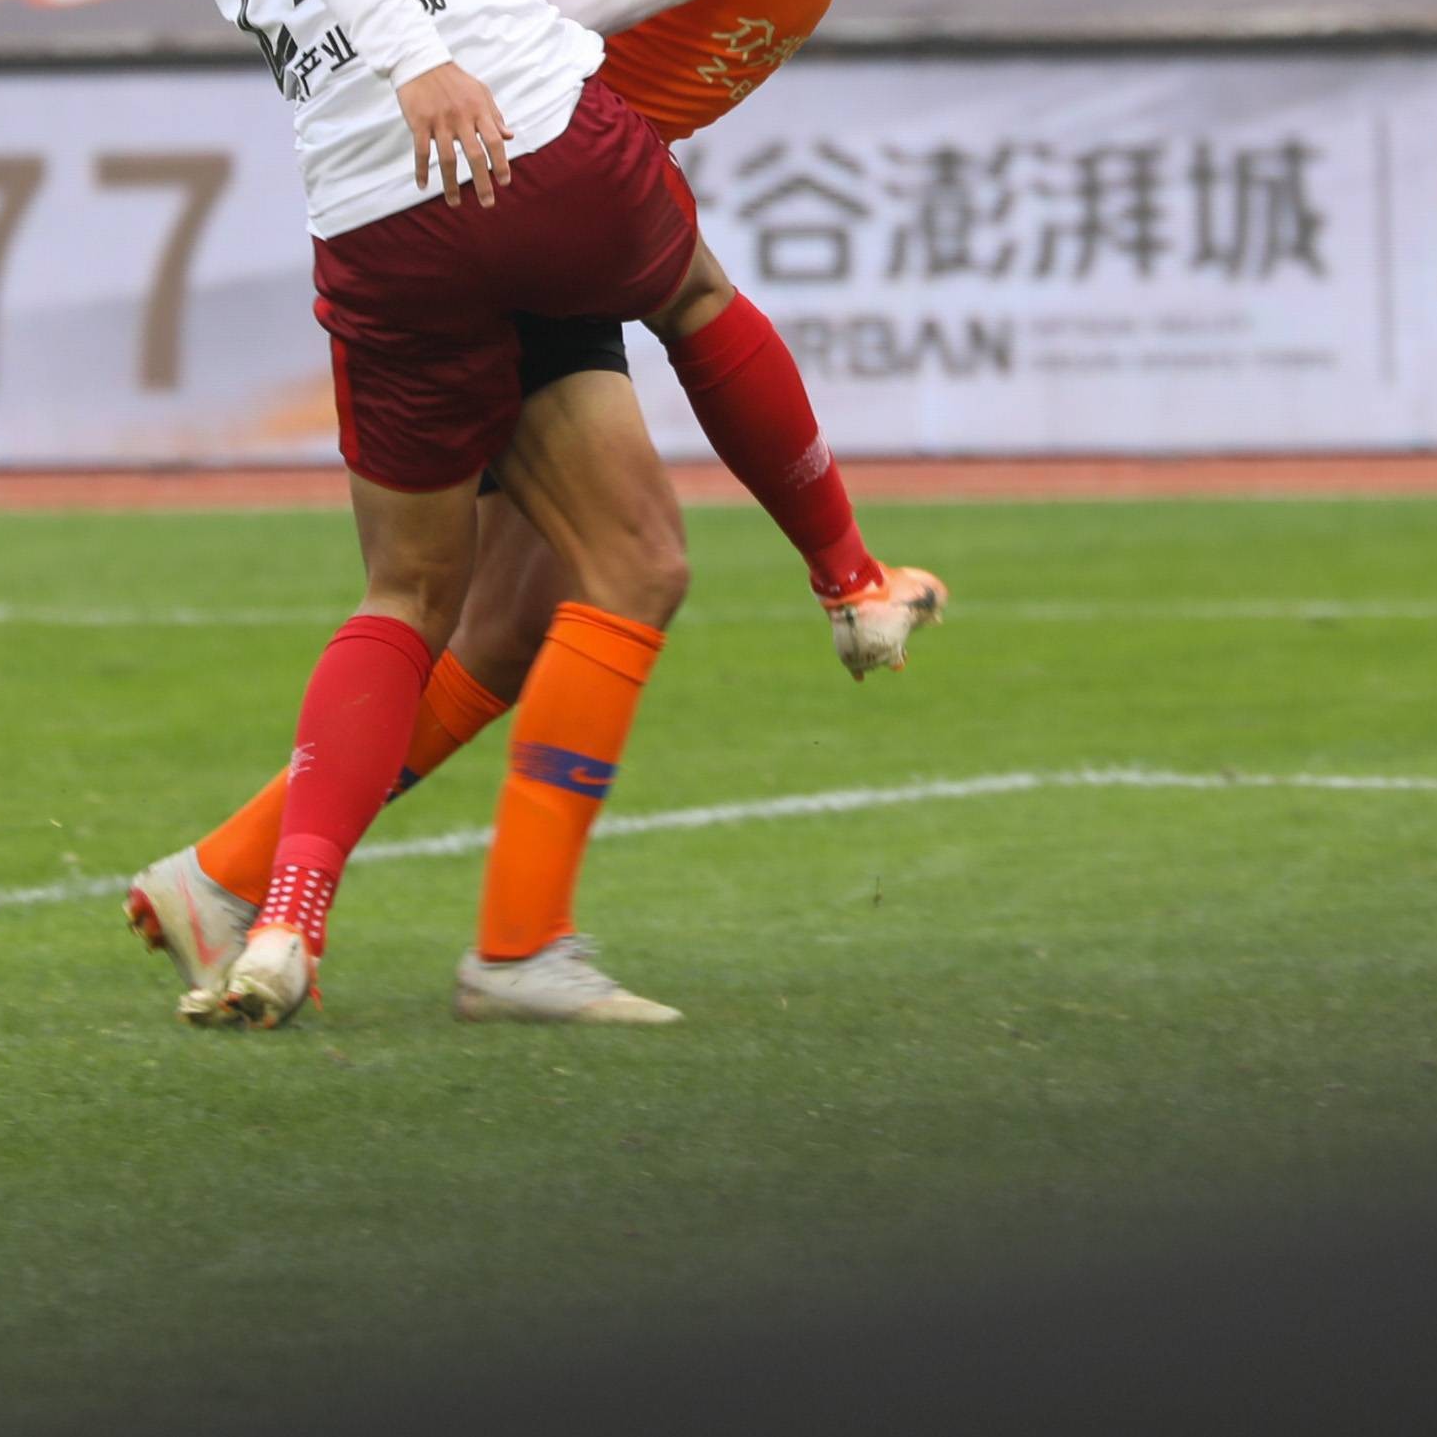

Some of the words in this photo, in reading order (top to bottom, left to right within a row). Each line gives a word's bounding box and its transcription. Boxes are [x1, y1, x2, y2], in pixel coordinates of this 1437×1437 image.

[676, 138, 1332, 282] 谷澎湃城
[786, 314, 1013, 376] RBAN
